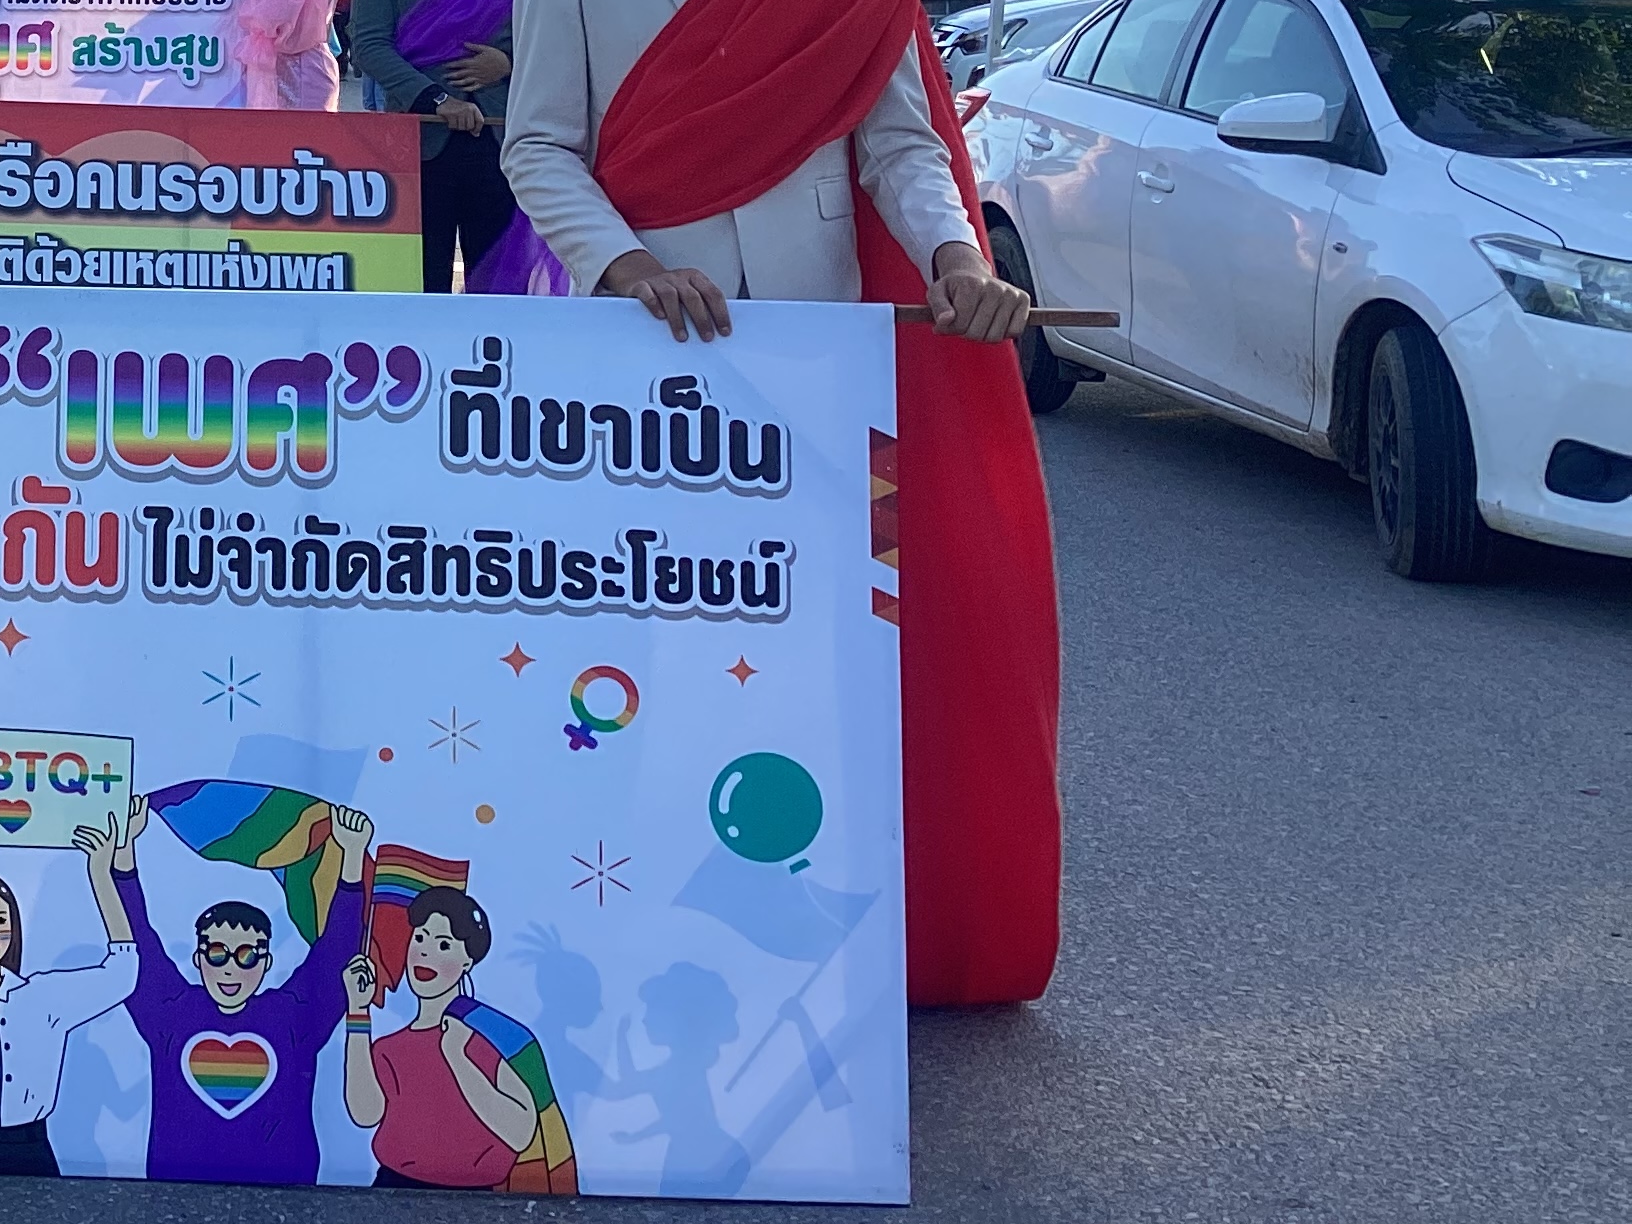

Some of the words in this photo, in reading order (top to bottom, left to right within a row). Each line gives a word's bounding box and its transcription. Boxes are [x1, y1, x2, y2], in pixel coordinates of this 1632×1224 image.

[72, 22, 220, 81] สร้างสุข
[448, 334, 783, 485] ที่เขาเป็น
[143, 505, 785, 608] ไม่จำกัดสิทธิประโยชน์
